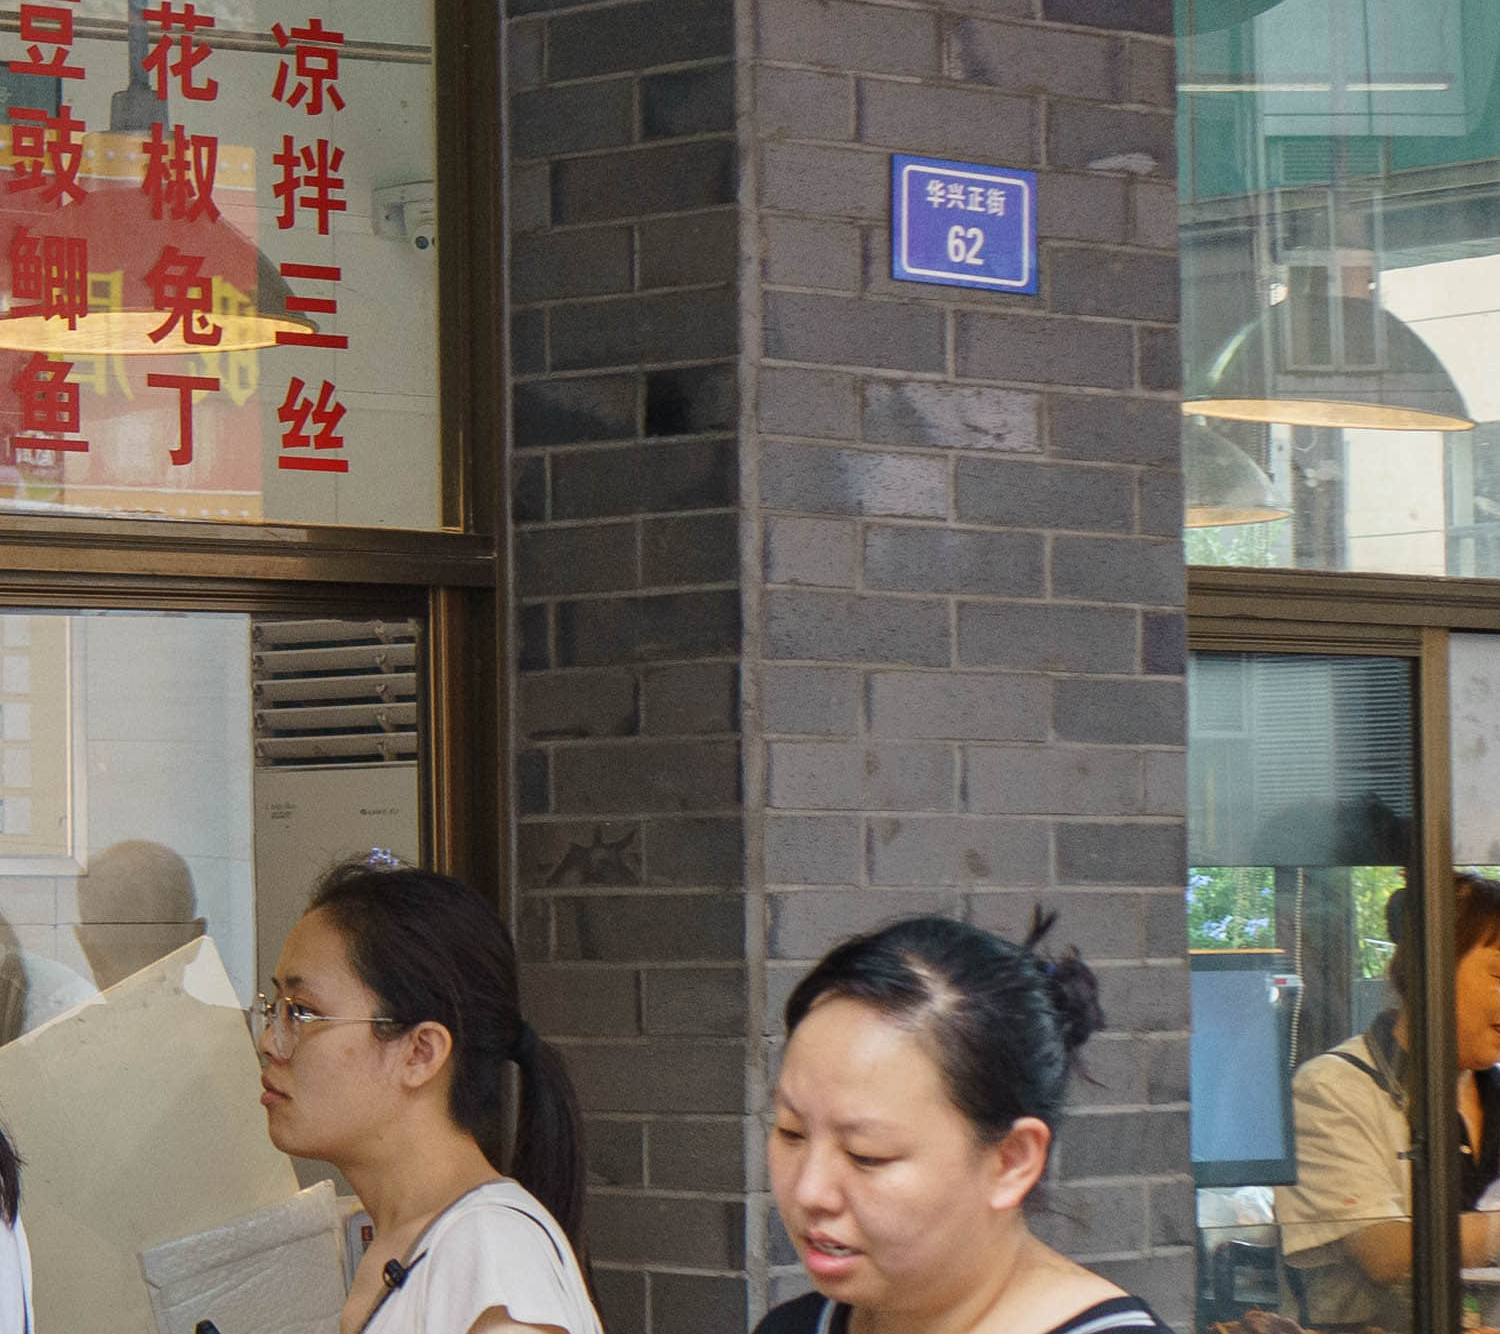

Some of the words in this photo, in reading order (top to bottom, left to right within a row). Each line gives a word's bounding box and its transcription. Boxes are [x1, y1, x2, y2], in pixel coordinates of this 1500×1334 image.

[141, 0, 222, 467] 花椒兔丁
[271, 17, 350, 474] 凉拌三丝
[925, 178, 1007, 217] 华兴正街
[946, 224, 986, 266] 62
